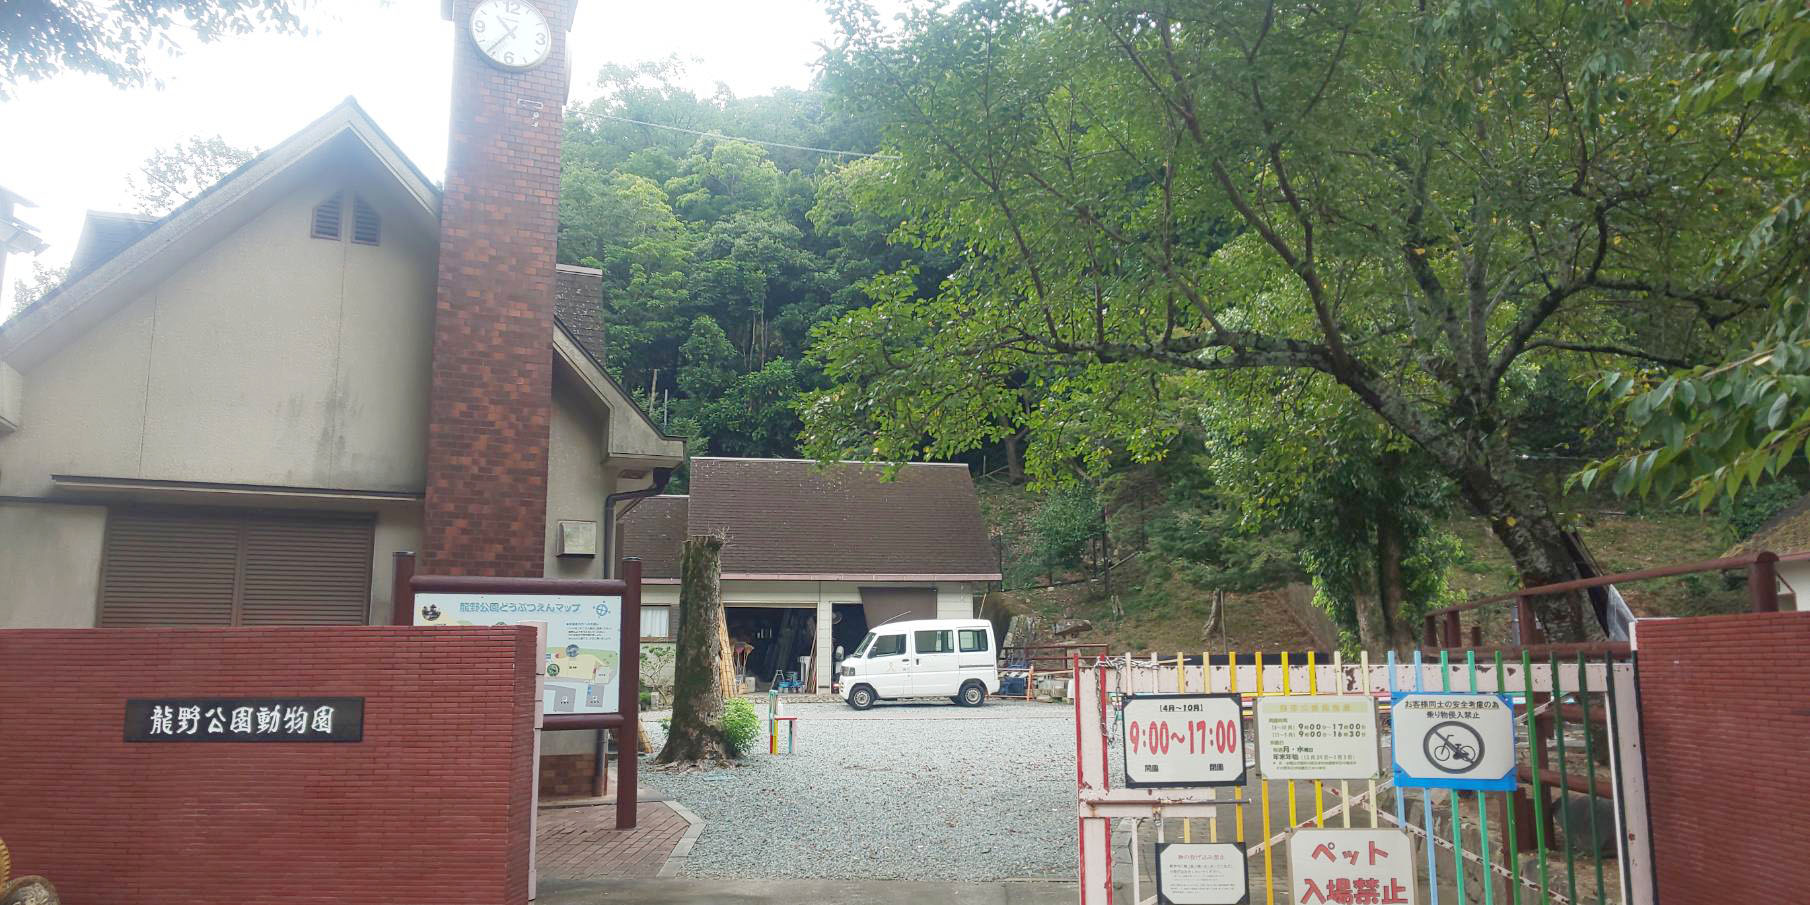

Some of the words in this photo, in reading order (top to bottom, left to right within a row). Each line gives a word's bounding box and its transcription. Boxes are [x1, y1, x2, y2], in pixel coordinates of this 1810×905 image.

[474, 20, 486, 33] 9
[535, 32, 546, 46] 3
[503, 51, 515, 65] 6
[1404, 700, 1500, 710] お客様同士の安全考慮の為
[149, 705, 335, 735] 龍野公園動物園
[1426, 711, 1481, 719] 乗り物侵入禁止
[1311, 840, 1389, 866] ペット
[1300, 877, 1409, 905] 入場禁止
